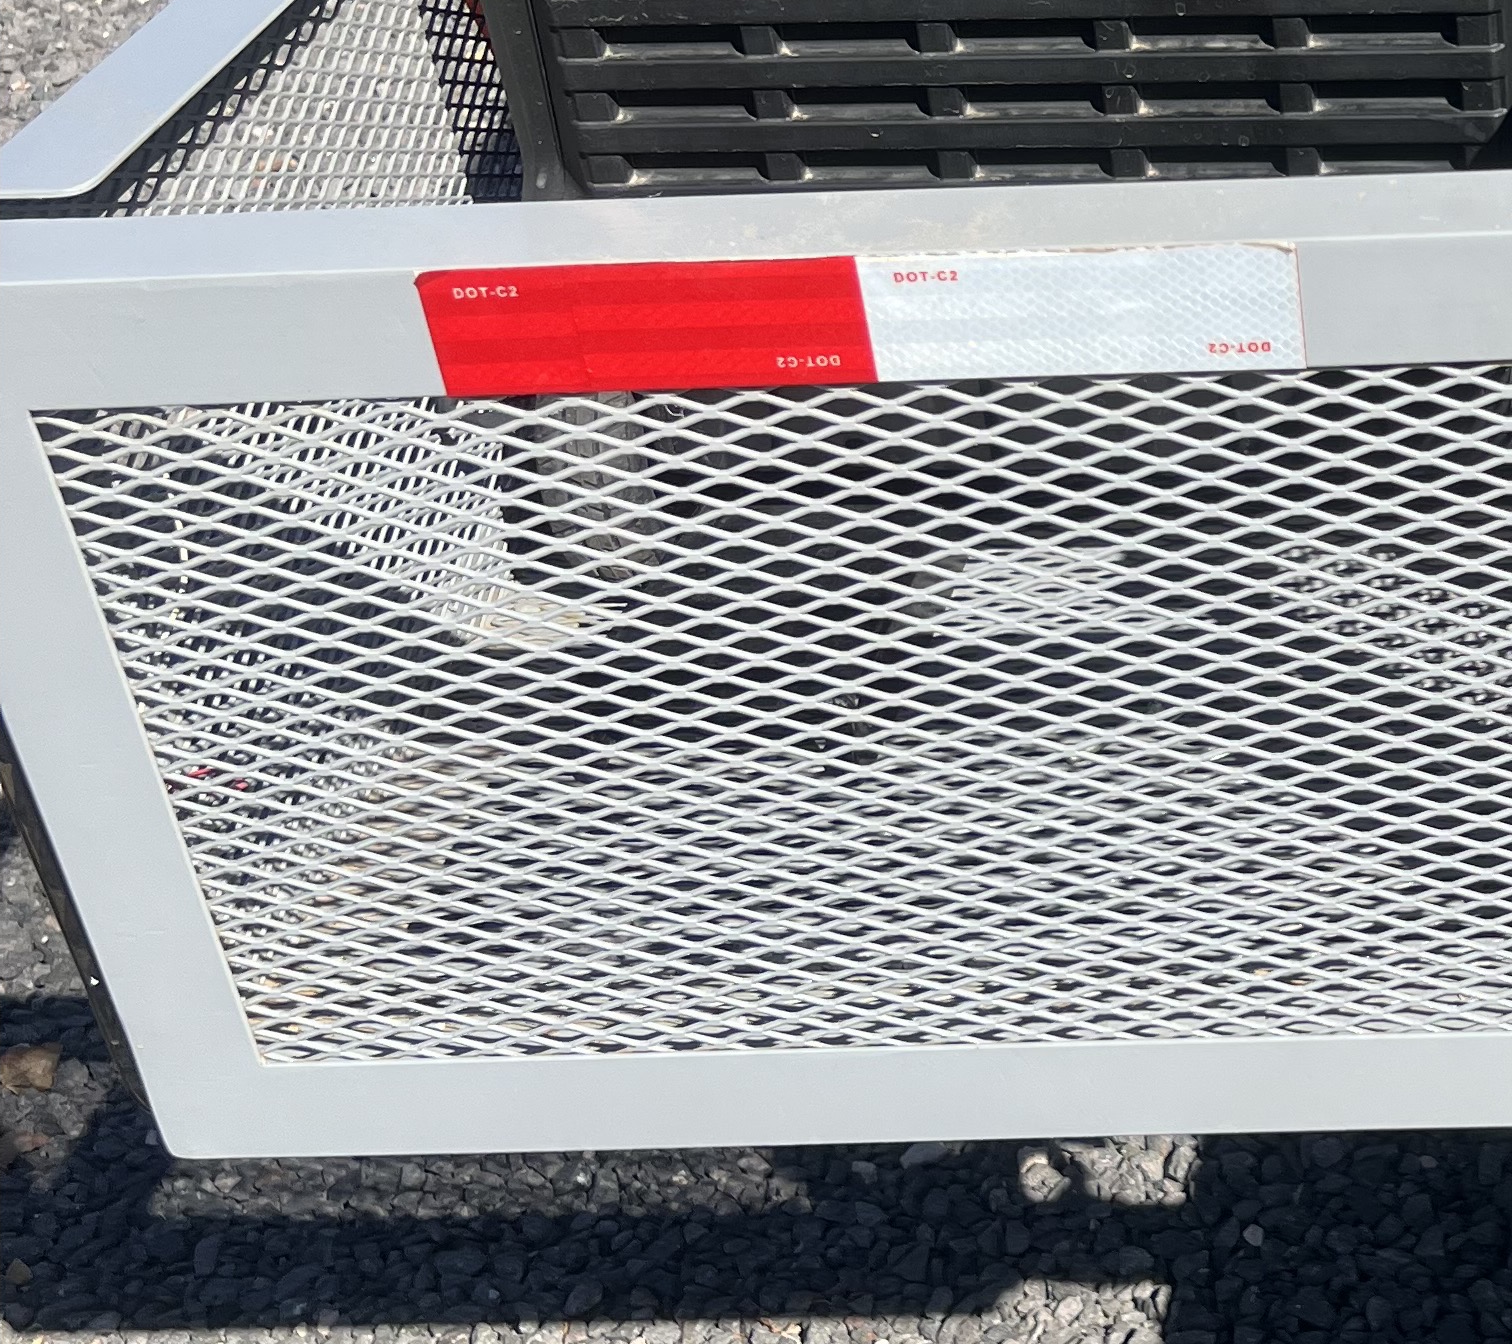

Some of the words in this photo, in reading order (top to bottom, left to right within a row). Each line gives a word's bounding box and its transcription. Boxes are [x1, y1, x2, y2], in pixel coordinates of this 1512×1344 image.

[892, 269, 959, 284] DOT-C2
[451, 285, 519, 300] DOT-C2
[1208, 341, 1271, 354] DOT-C2
[776, 354, 841, 368] DOT-C2
